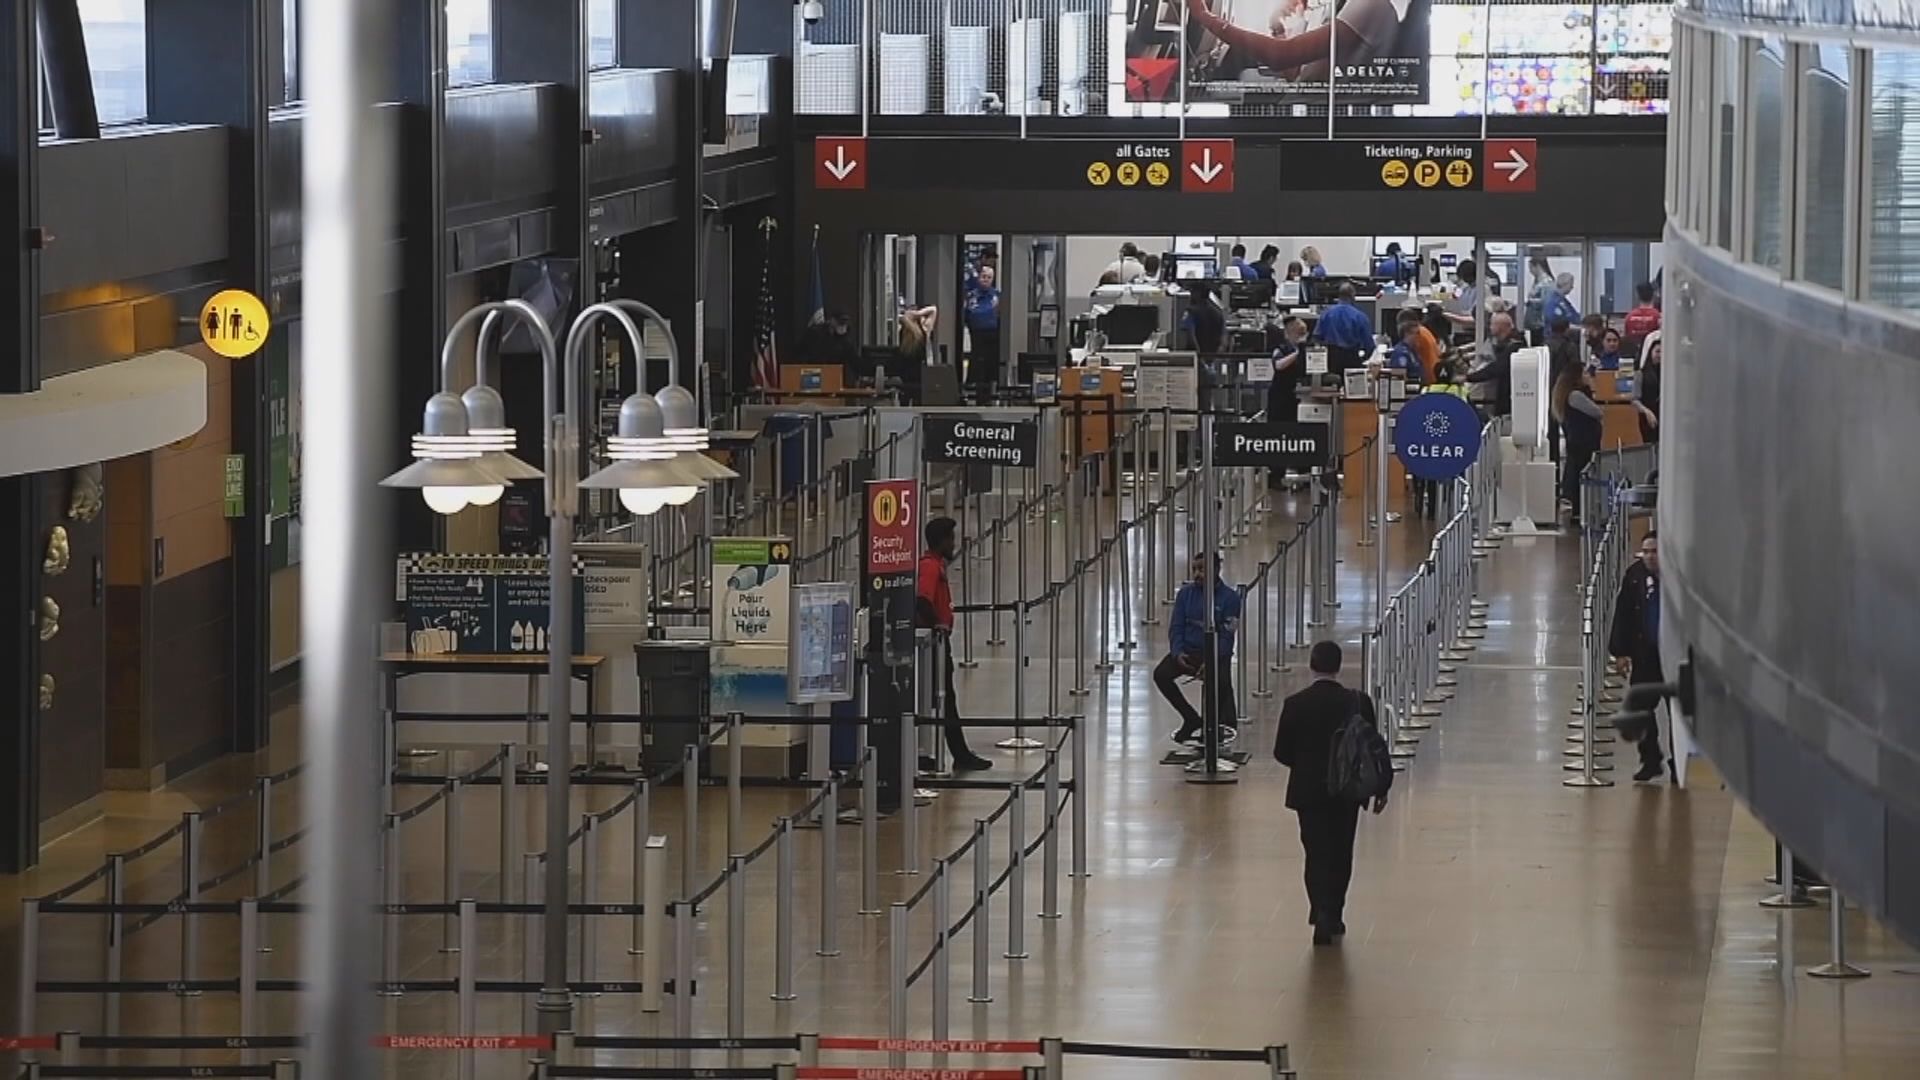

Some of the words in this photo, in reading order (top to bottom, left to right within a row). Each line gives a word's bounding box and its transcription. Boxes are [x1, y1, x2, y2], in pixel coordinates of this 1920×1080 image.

[1347, 66, 1395, 77] DELTA
[1116, 143, 1132, 158] all
[1135, 143, 1171, 158] Gates
[1364, 143, 1423, 160] Ticketing,
[1426, 143, 1473, 160] Parking
[954, 421, 1015, 441] General
[1235, 433, 1316, 453] Premium
[945, 440, 1021, 465] Screening
[1407, 443, 1464, 458] CLEAR
[900, 488, 912, 527] 5
[872, 535, 904, 550] Security
[442, 558, 455, 569] TO
[458, 558, 490, 569] SPEED
[492, 558, 528, 569] THINGS
[872, 549, 913, 566] Checkpoint
[508, 579, 528, 587] Leave
[739, 593, 765, 604] Pour
[731, 606, 771, 620] Liquids
[735, 620, 768, 633] Here
[226, 1038, 249, 1047] SEA
[390, 1036, 469, 1048] EMERGENCY
[473, 1037, 501, 1048] EXIT
[878, 1040, 956, 1051] EMERGENCY
[960, 1041, 986, 1051] EXIT
[191, 1067, 214, 1076] SEA
[857, 1069, 937, 1080] EMERGENCY
[941, 1070, 969, 1080] EXIT
